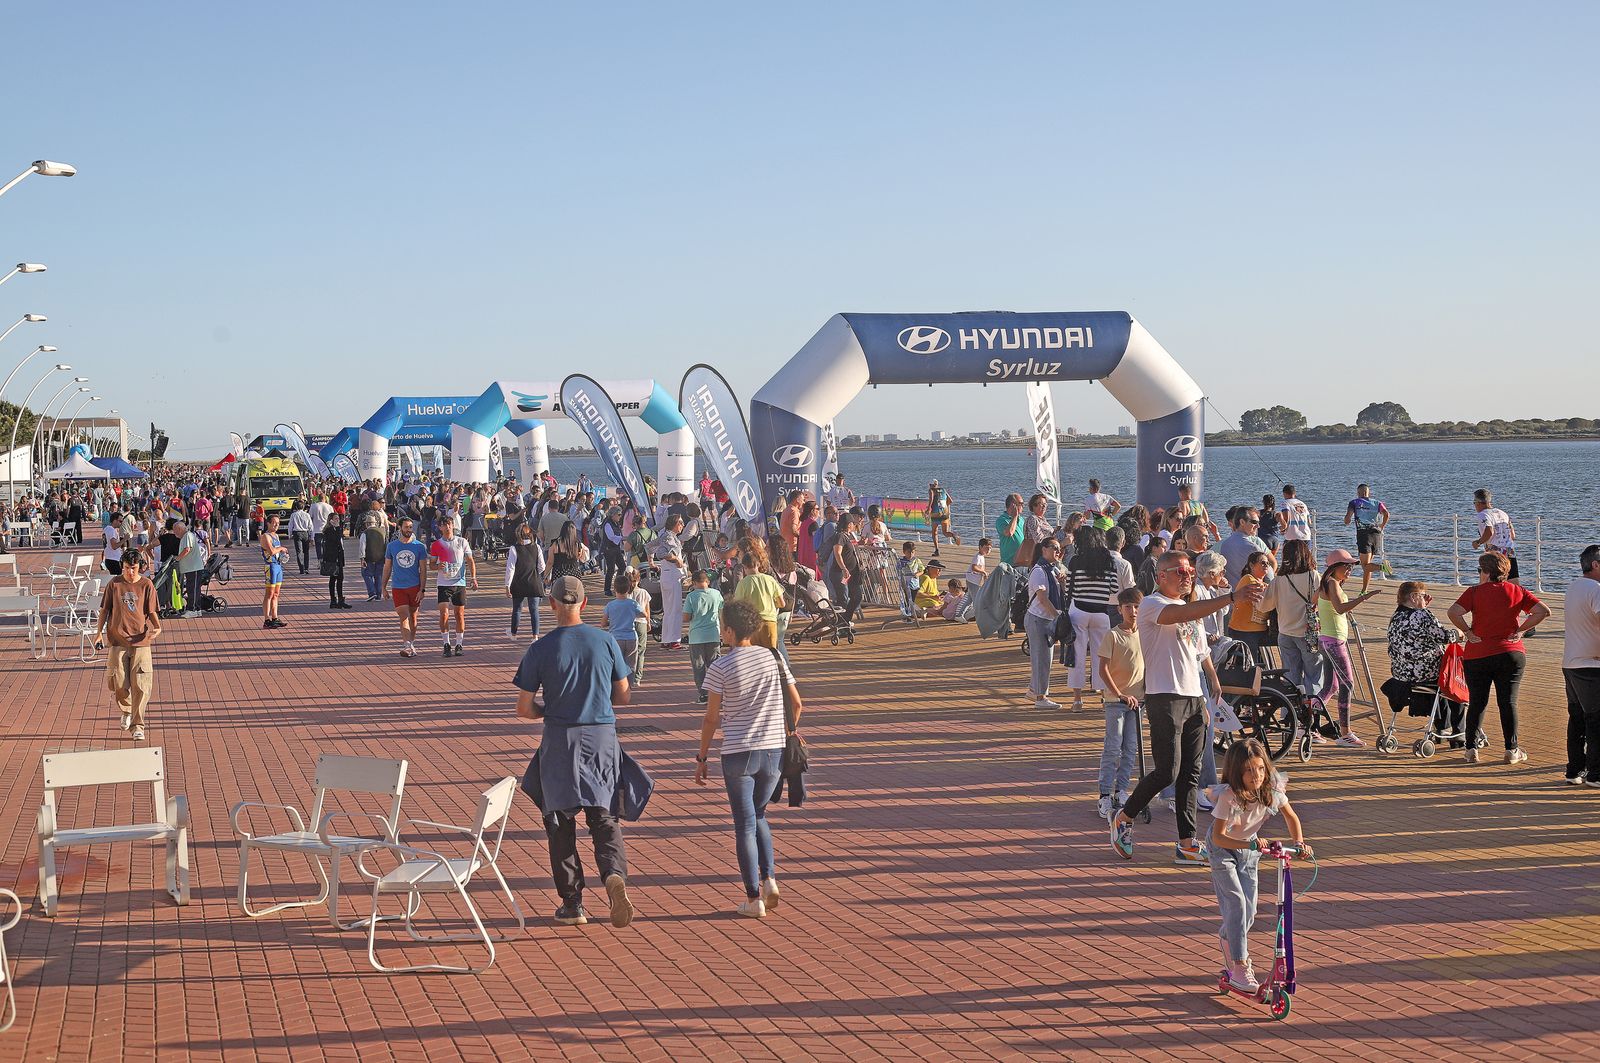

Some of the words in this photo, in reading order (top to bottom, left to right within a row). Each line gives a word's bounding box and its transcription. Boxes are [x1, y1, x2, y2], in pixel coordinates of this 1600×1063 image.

[959, 327, 1094, 350] HYUNDAI
[986, 357, 1062, 379] Syrluz
[407, 403, 453, 416] Huelva
[614, 401, 640, 410] PPER
[413, 432, 434, 440] Huelva
[1157, 462, 1204, 473] HYUNDA
[766, 473, 817, 483] HYUNDAI
[1170, 475, 1198, 486] Syrluz
